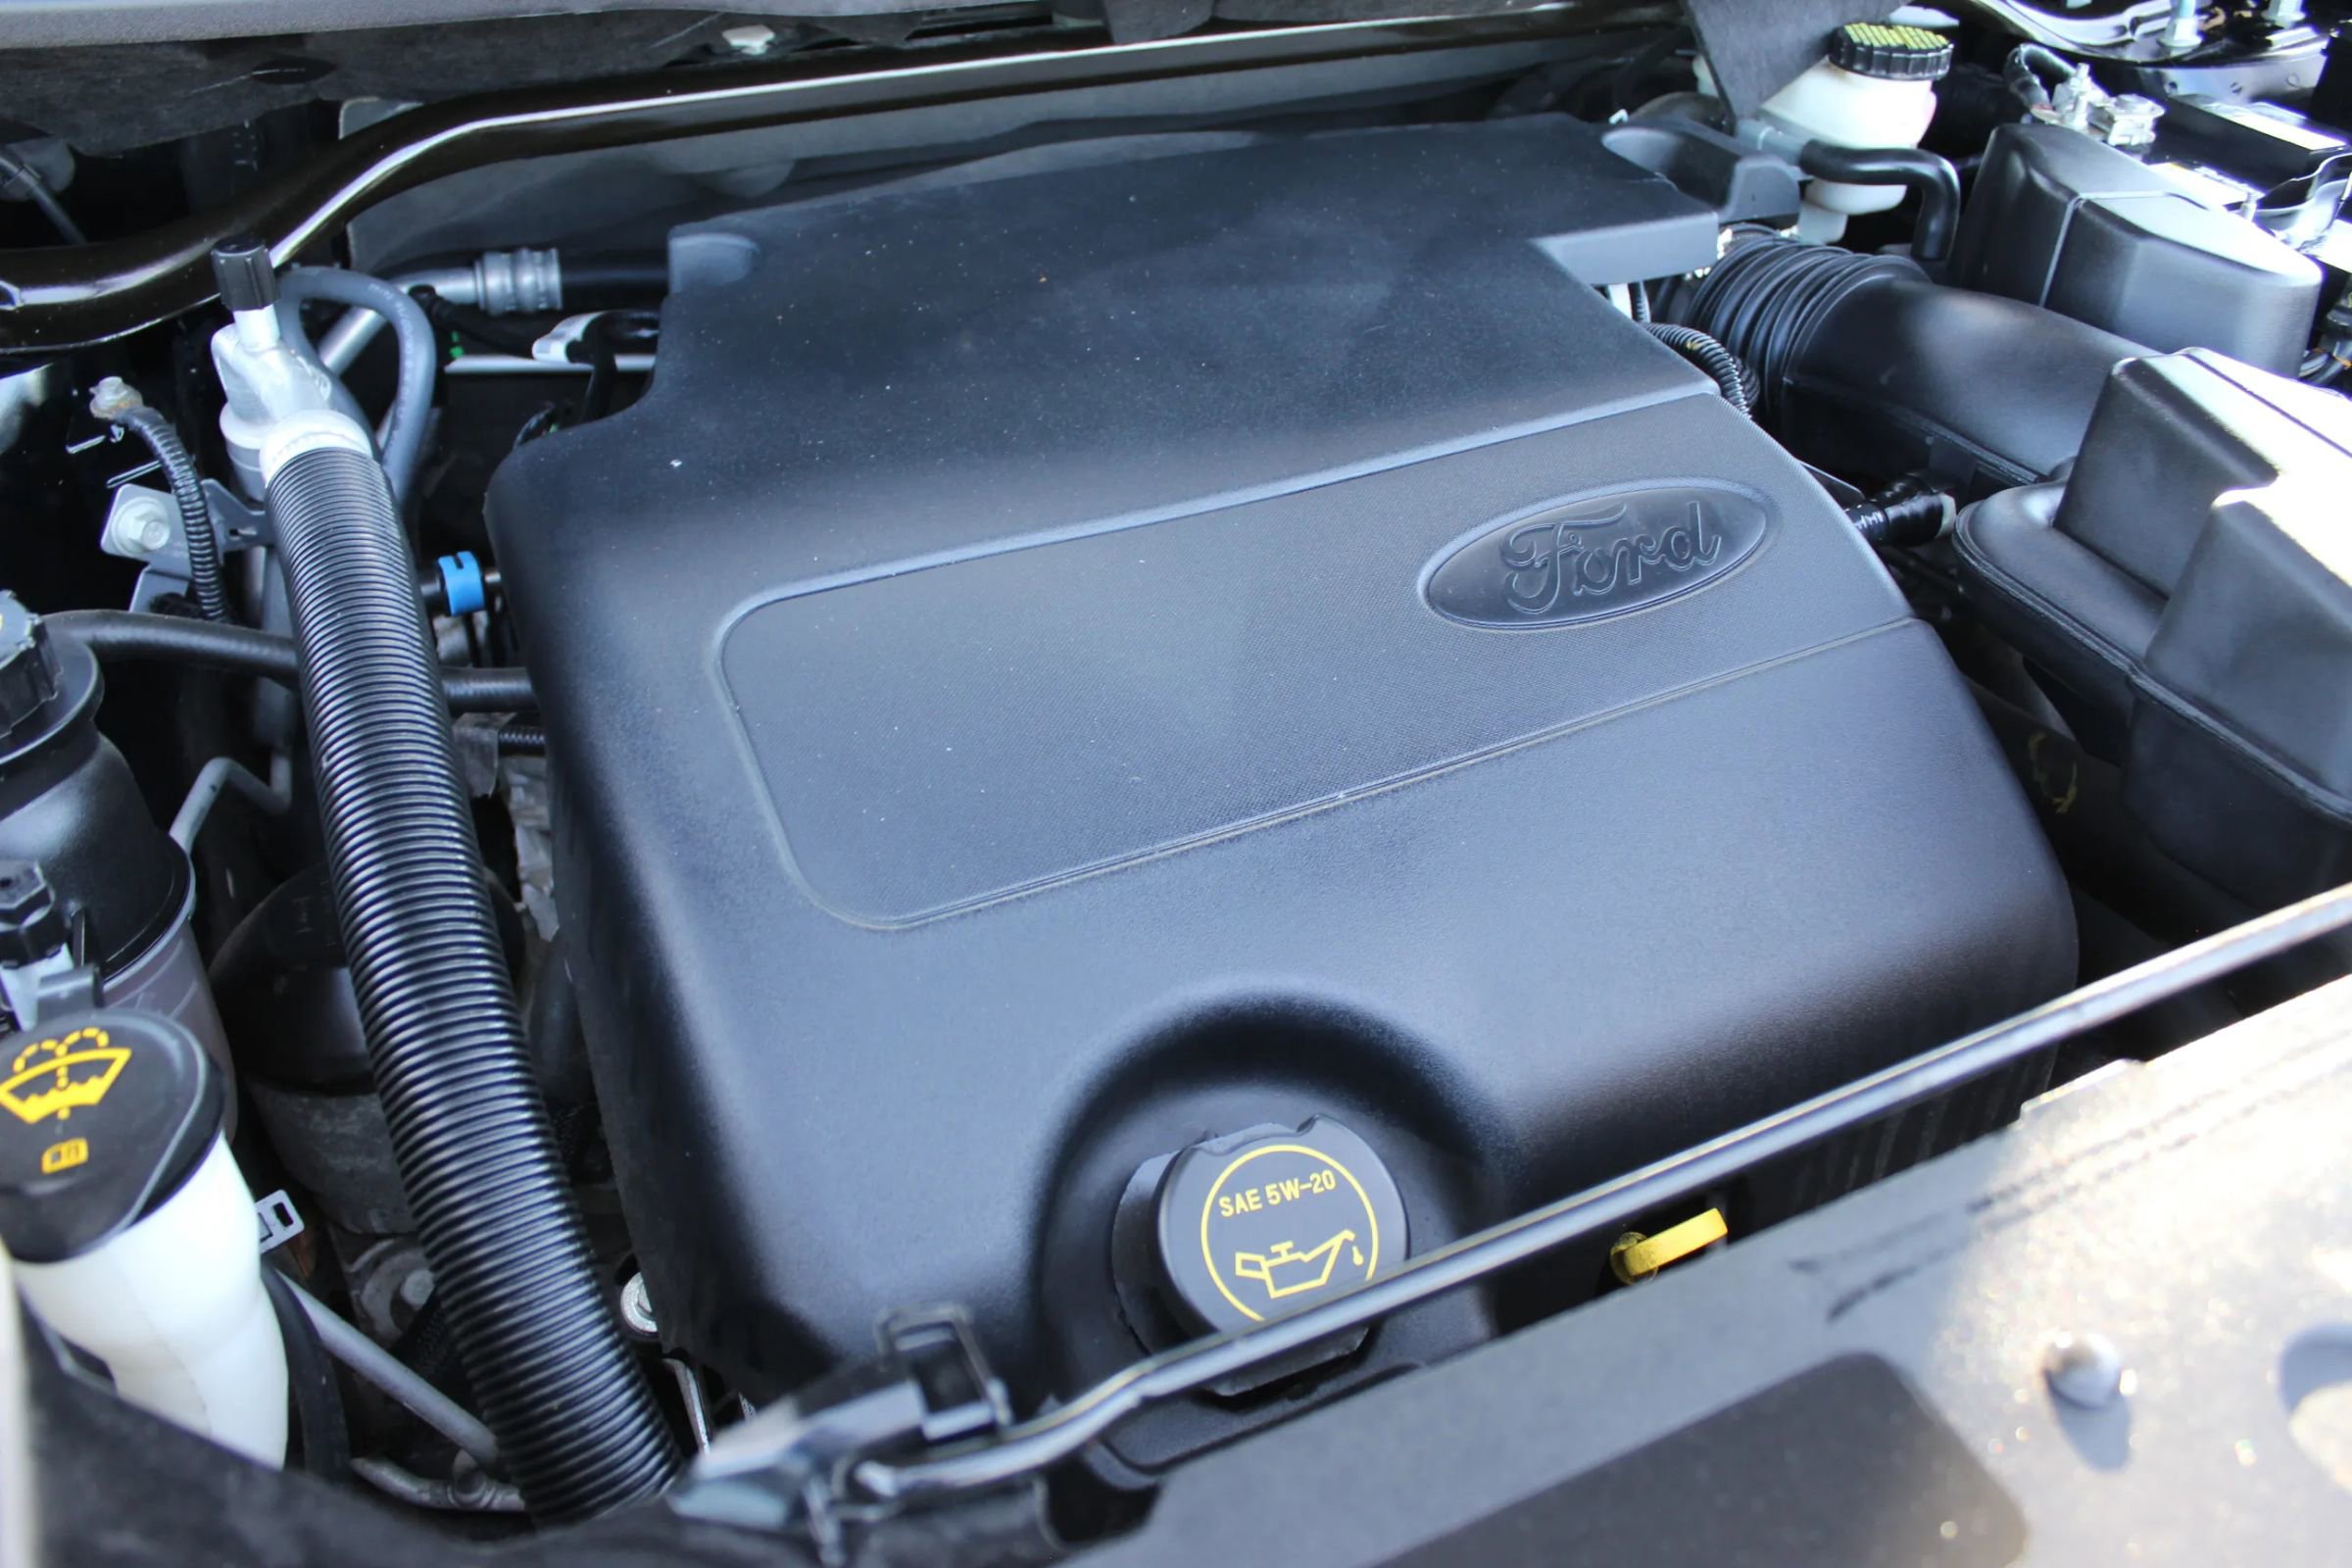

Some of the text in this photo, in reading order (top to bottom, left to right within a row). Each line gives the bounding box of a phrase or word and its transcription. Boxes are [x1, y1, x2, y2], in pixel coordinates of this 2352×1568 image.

[1499, 501, 1722, 614] Ford
[1219, 1169, 1337, 1217] SAE 5W-20
